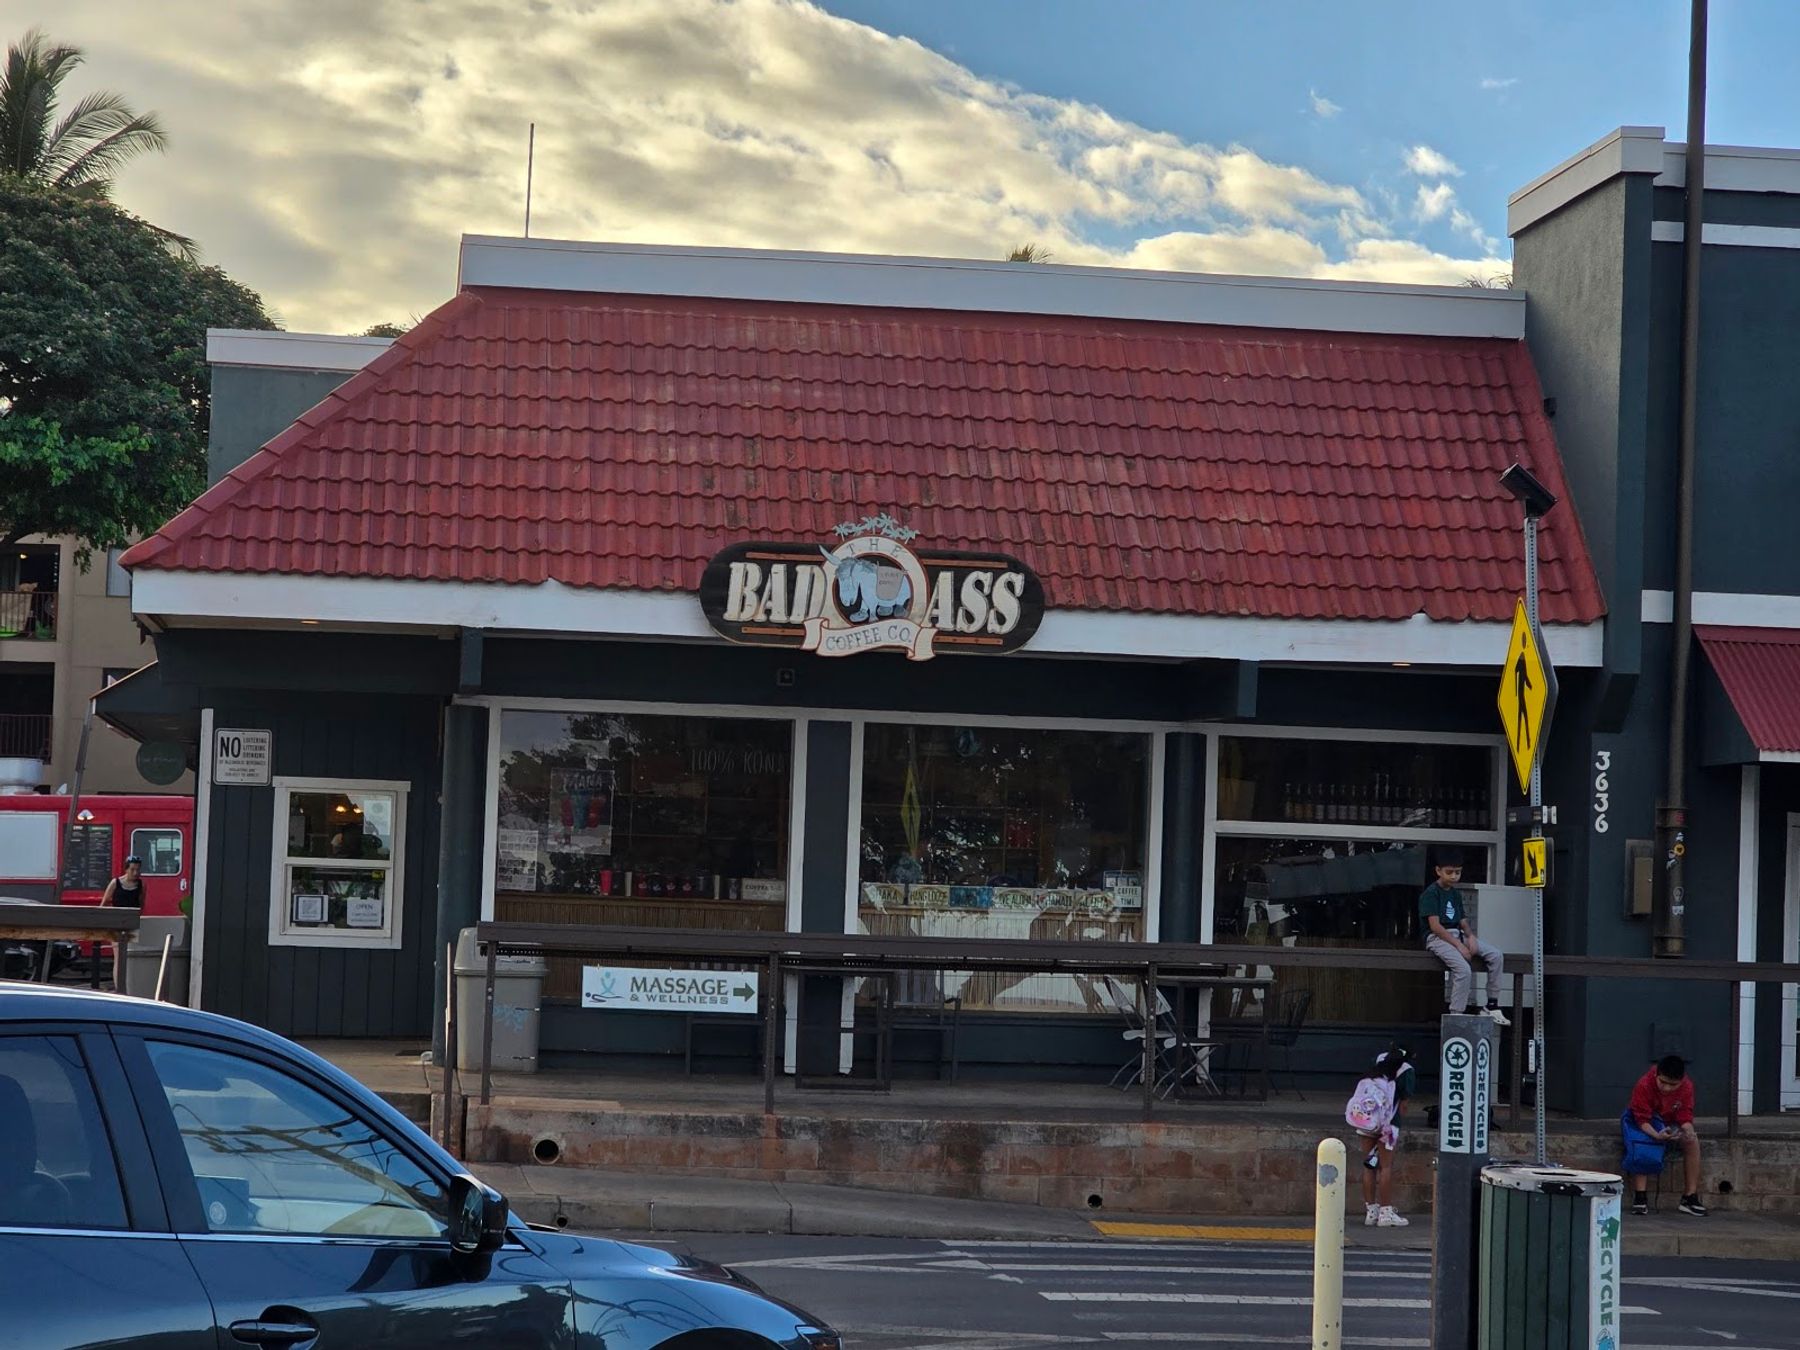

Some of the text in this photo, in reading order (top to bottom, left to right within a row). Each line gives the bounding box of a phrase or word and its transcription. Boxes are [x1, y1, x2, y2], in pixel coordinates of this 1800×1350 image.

[723, 562, 1025, 634] BAD ASS
[825, 625, 911, 651] COFFEE CO.
[220, 736, 241, 758] NO
[1593, 750, 1611, 833] 3636
[1117, 887, 1138, 895] COFFEE
[1120, 897, 1135, 906] TIME
[630, 976, 728, 996] MASSAGE
[630, 994, 729, 1005] & WELLNESS
[1448, 1071, 1465, 1139] RECYCLE
[1477, 1072, 1485, 1139] RECYCLE
